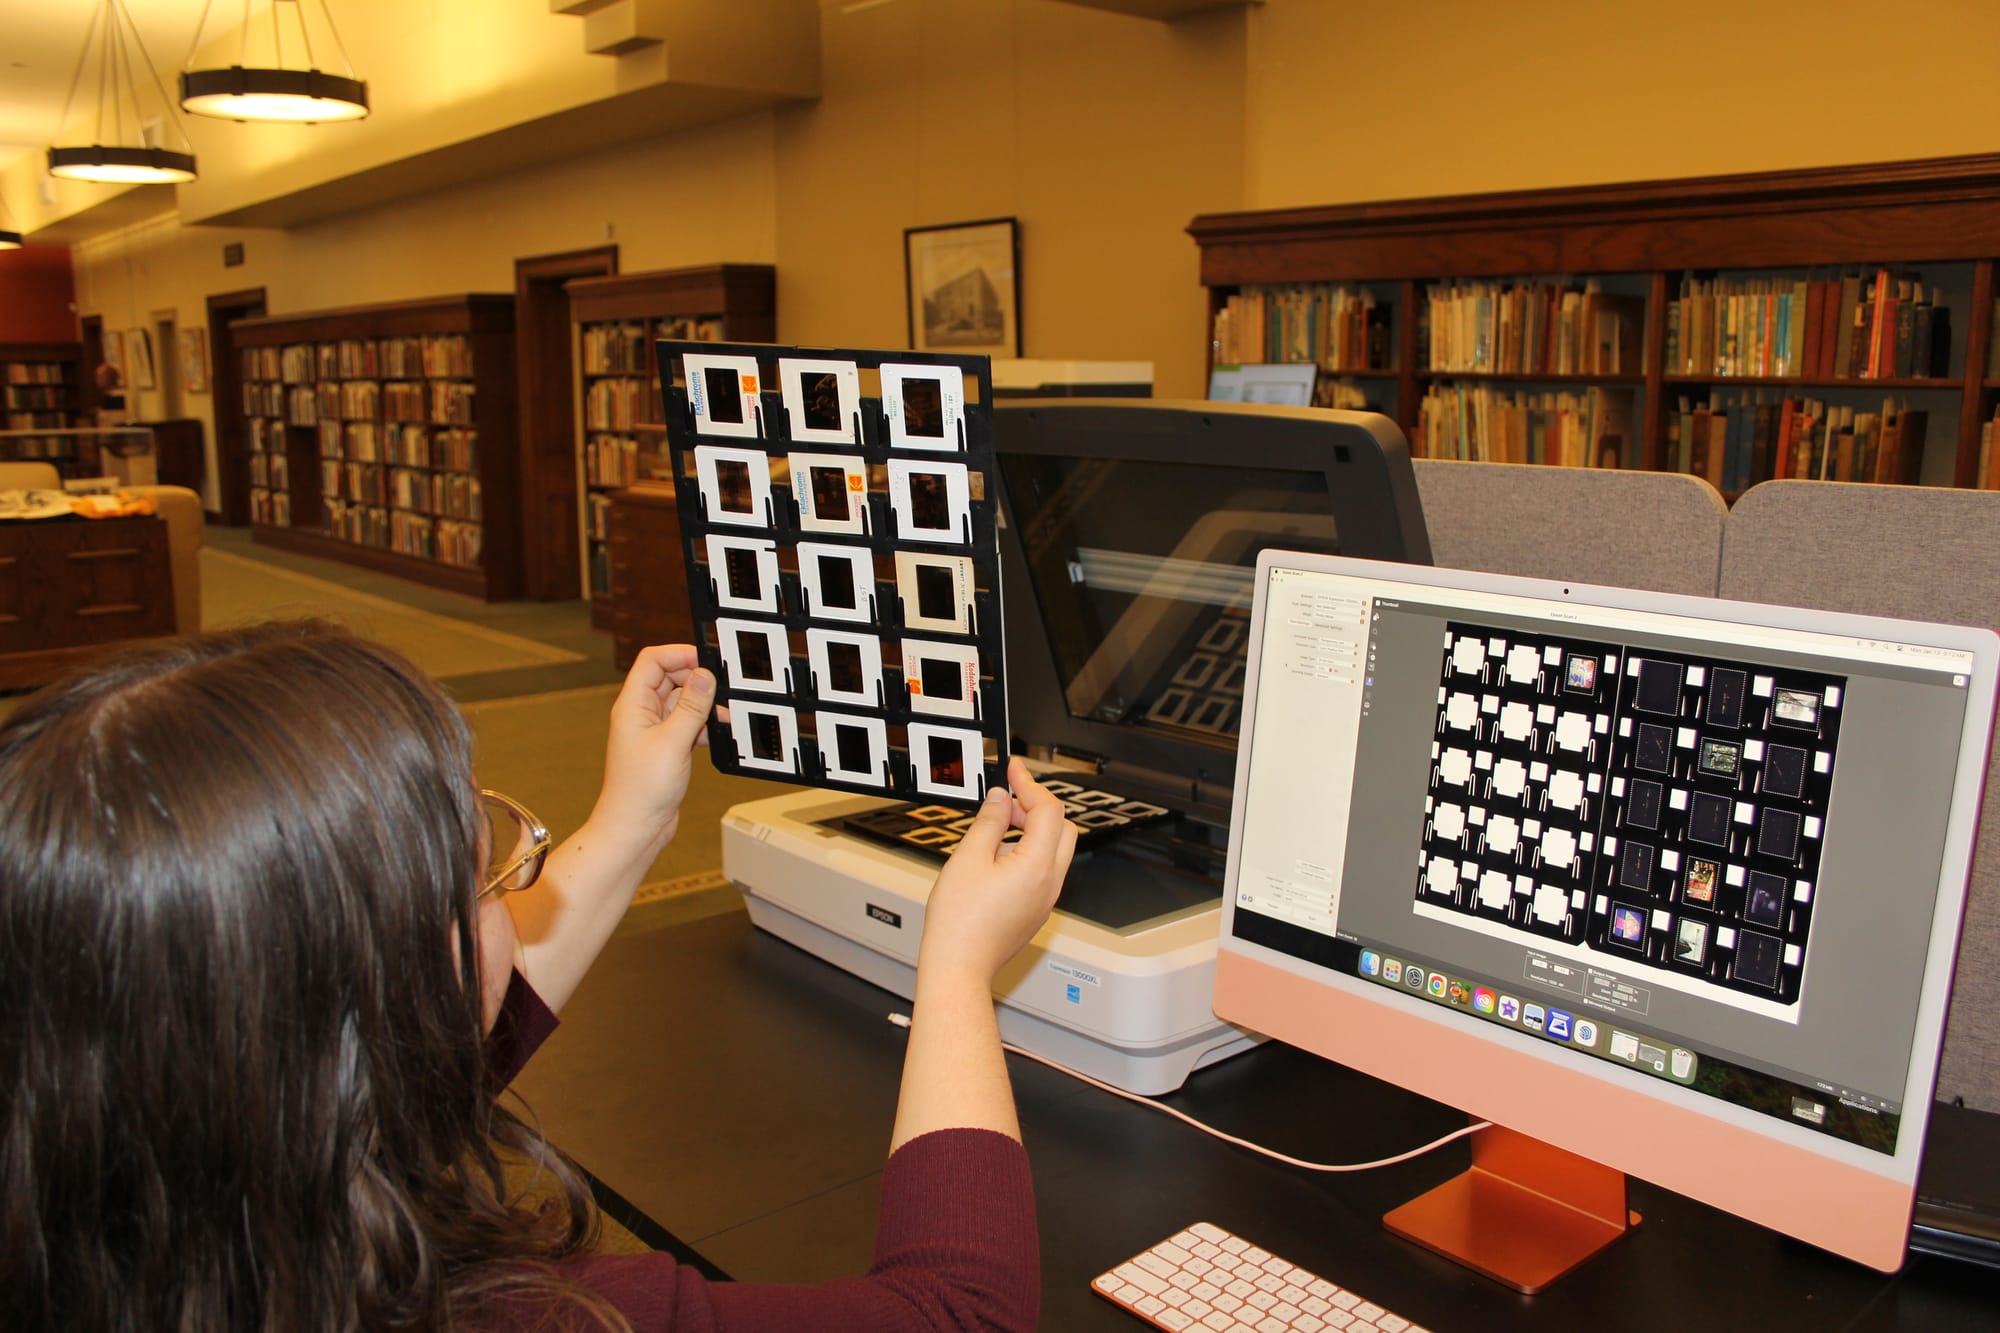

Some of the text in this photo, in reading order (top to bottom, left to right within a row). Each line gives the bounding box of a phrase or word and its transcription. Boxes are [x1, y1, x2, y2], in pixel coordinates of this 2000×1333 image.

[691, 371, 701, 417] Ektachrome
[796, 471, 806, 515] Ektachrome
[872, 908, 894, 924] EPSON
[1838, 1097, 1879, 1114] Applications
